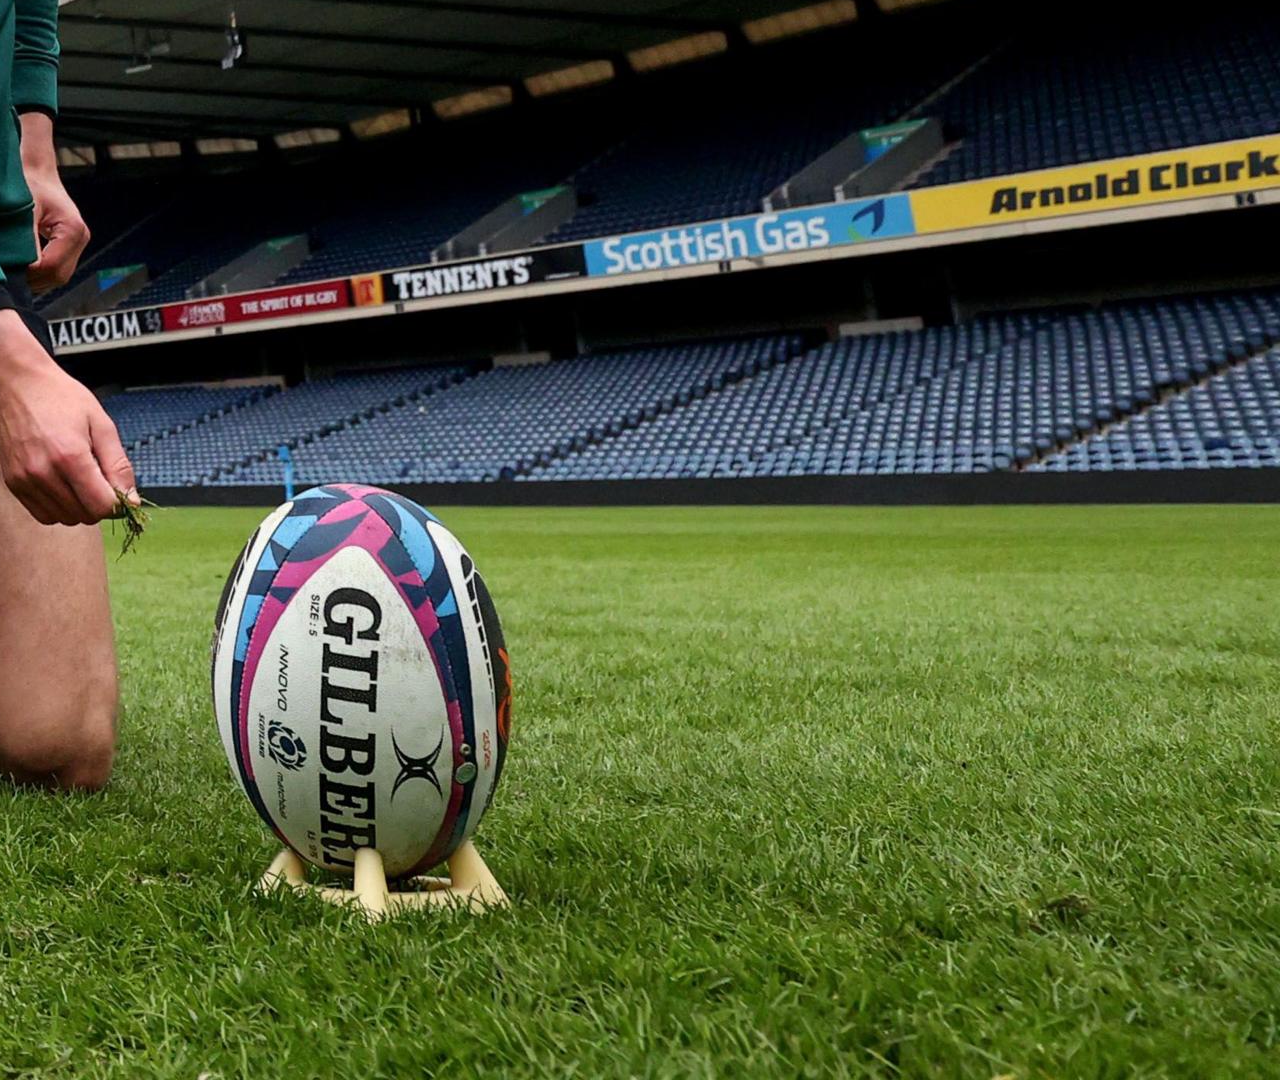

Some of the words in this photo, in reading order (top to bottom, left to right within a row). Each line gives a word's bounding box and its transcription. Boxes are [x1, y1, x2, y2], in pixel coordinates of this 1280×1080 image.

[990, 169, 1140, 215] Arnold
[1149, 150, 1280, 192] Clark
[602, 221, 749, 274] Scottish
[755, 215, 830, 254] Gas
[241, 301, 259, 314] THE
[260, 297, 289, 311] SPIRIT
[289, 295, 303, 307] OF
[304, 290, 338, 306] RUGBY
[258, 712, 266, 758] SCOTLAND
